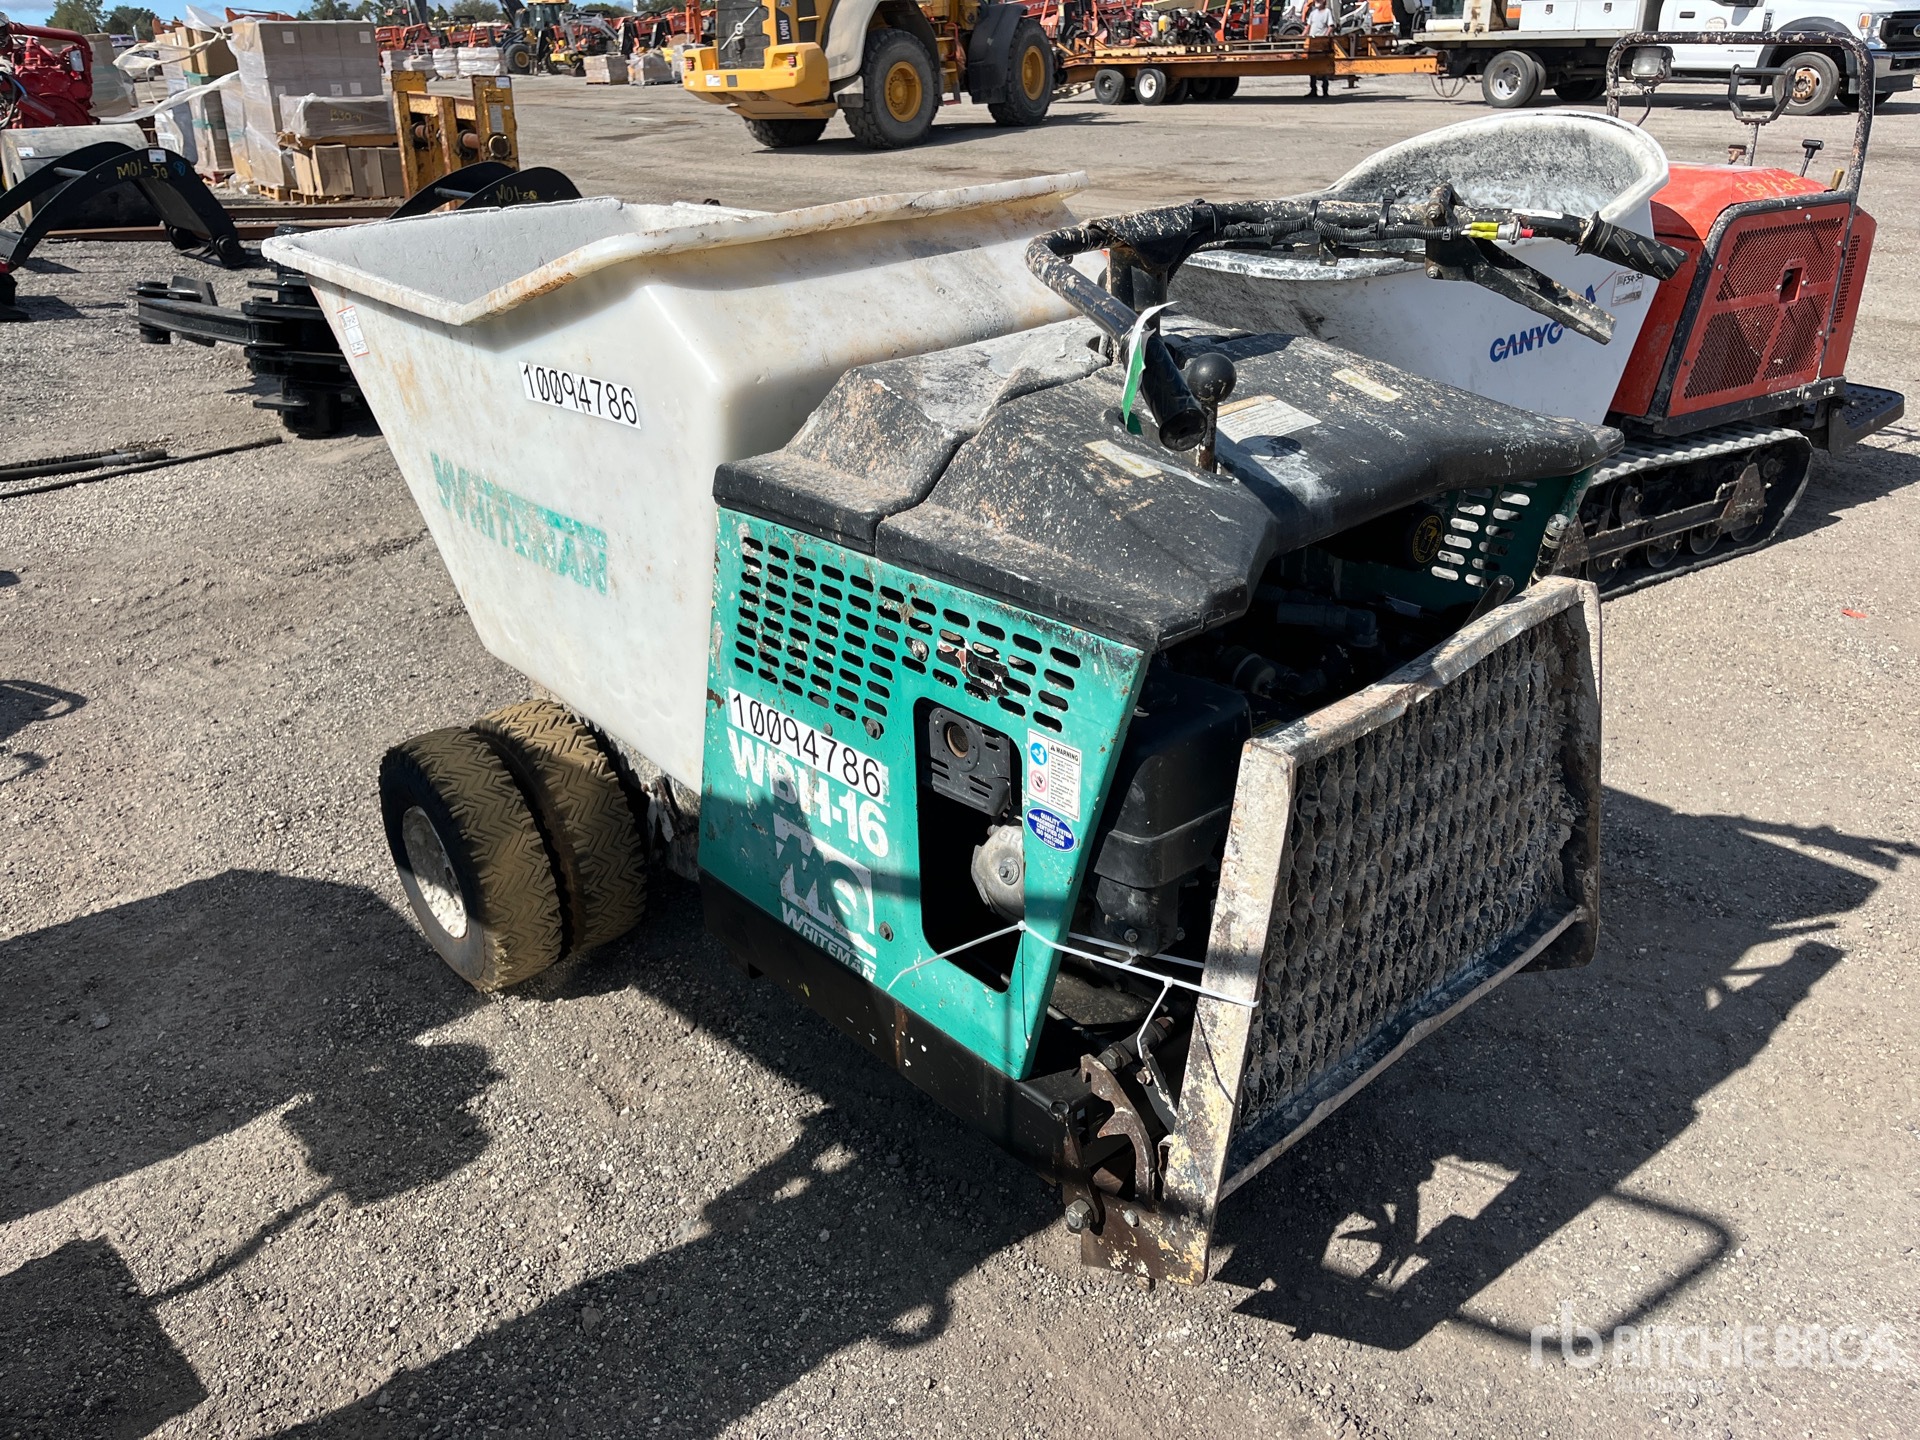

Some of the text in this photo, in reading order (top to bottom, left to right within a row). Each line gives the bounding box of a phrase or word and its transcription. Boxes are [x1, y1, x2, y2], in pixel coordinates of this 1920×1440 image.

[779, 20, 790, 40] L90H
[523, 364, 638, 425] 10094786
[733, 692, 880, 798] 10094786
[1055, 745, 1079, 762] WARNING
[727, 727, 889, 858] WBH-16
[1040, 812, 1060, 826] QUALITY
[781, 901, 877, 983] WHITEMAN
